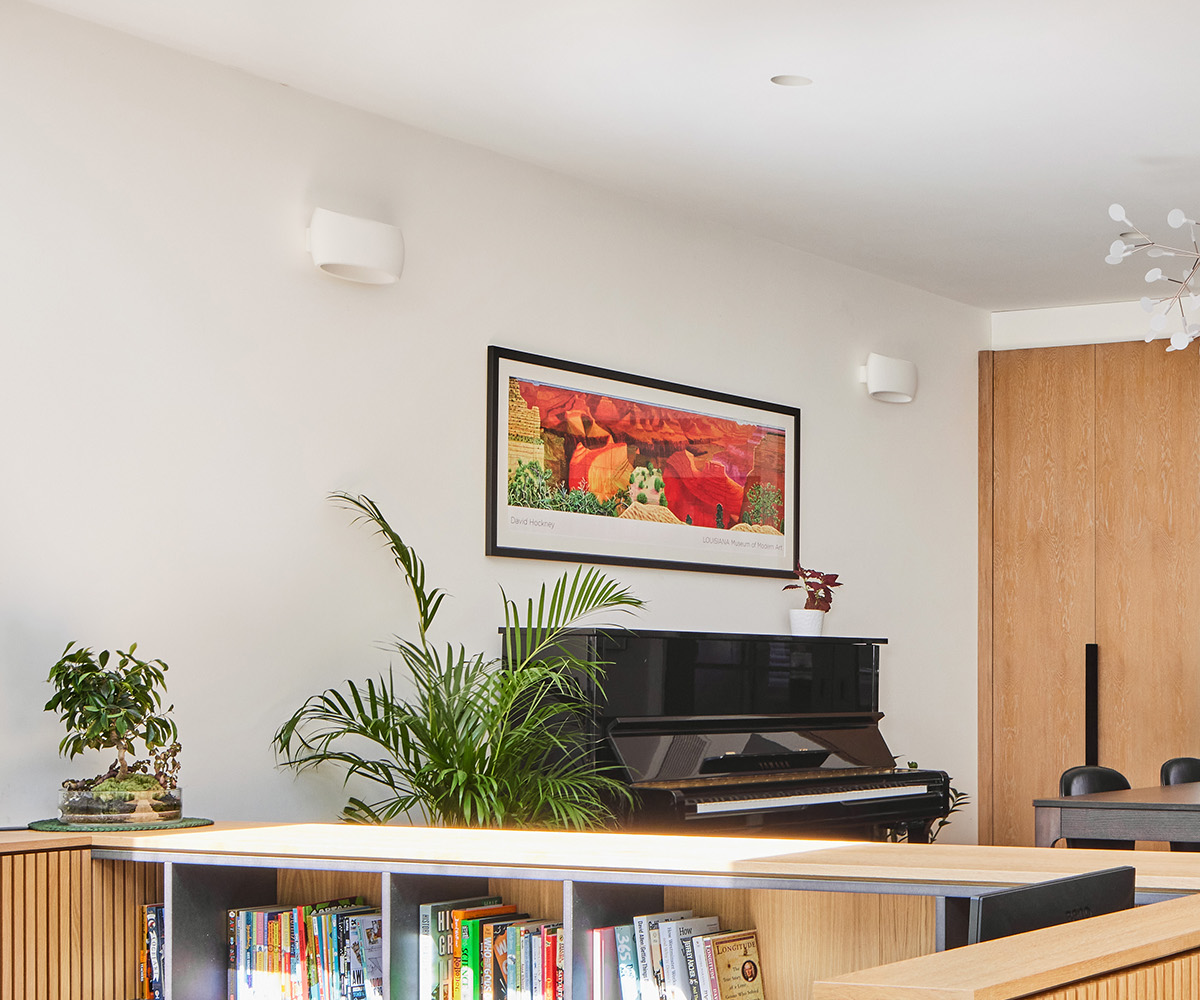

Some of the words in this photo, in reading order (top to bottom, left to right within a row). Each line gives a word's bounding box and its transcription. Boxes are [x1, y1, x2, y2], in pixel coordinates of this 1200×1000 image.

[510, 516, 528, 526] David
[529, 519, 556, 529] Hockney
[702, 536, 729, 545] LOUISIANA
[730, 540, 750, 548] Museum
[757, 542, 775, 550] Modern
[678, 927, 693, 936] How
[484, 937, 492, 958] WHO
[618, 933, 631, 961] 365
[716, 941, 756, 956] LONGITUDE
[706, 945, 715, 980] LONGITUDE
[484, 969, 492, 992] GODS
